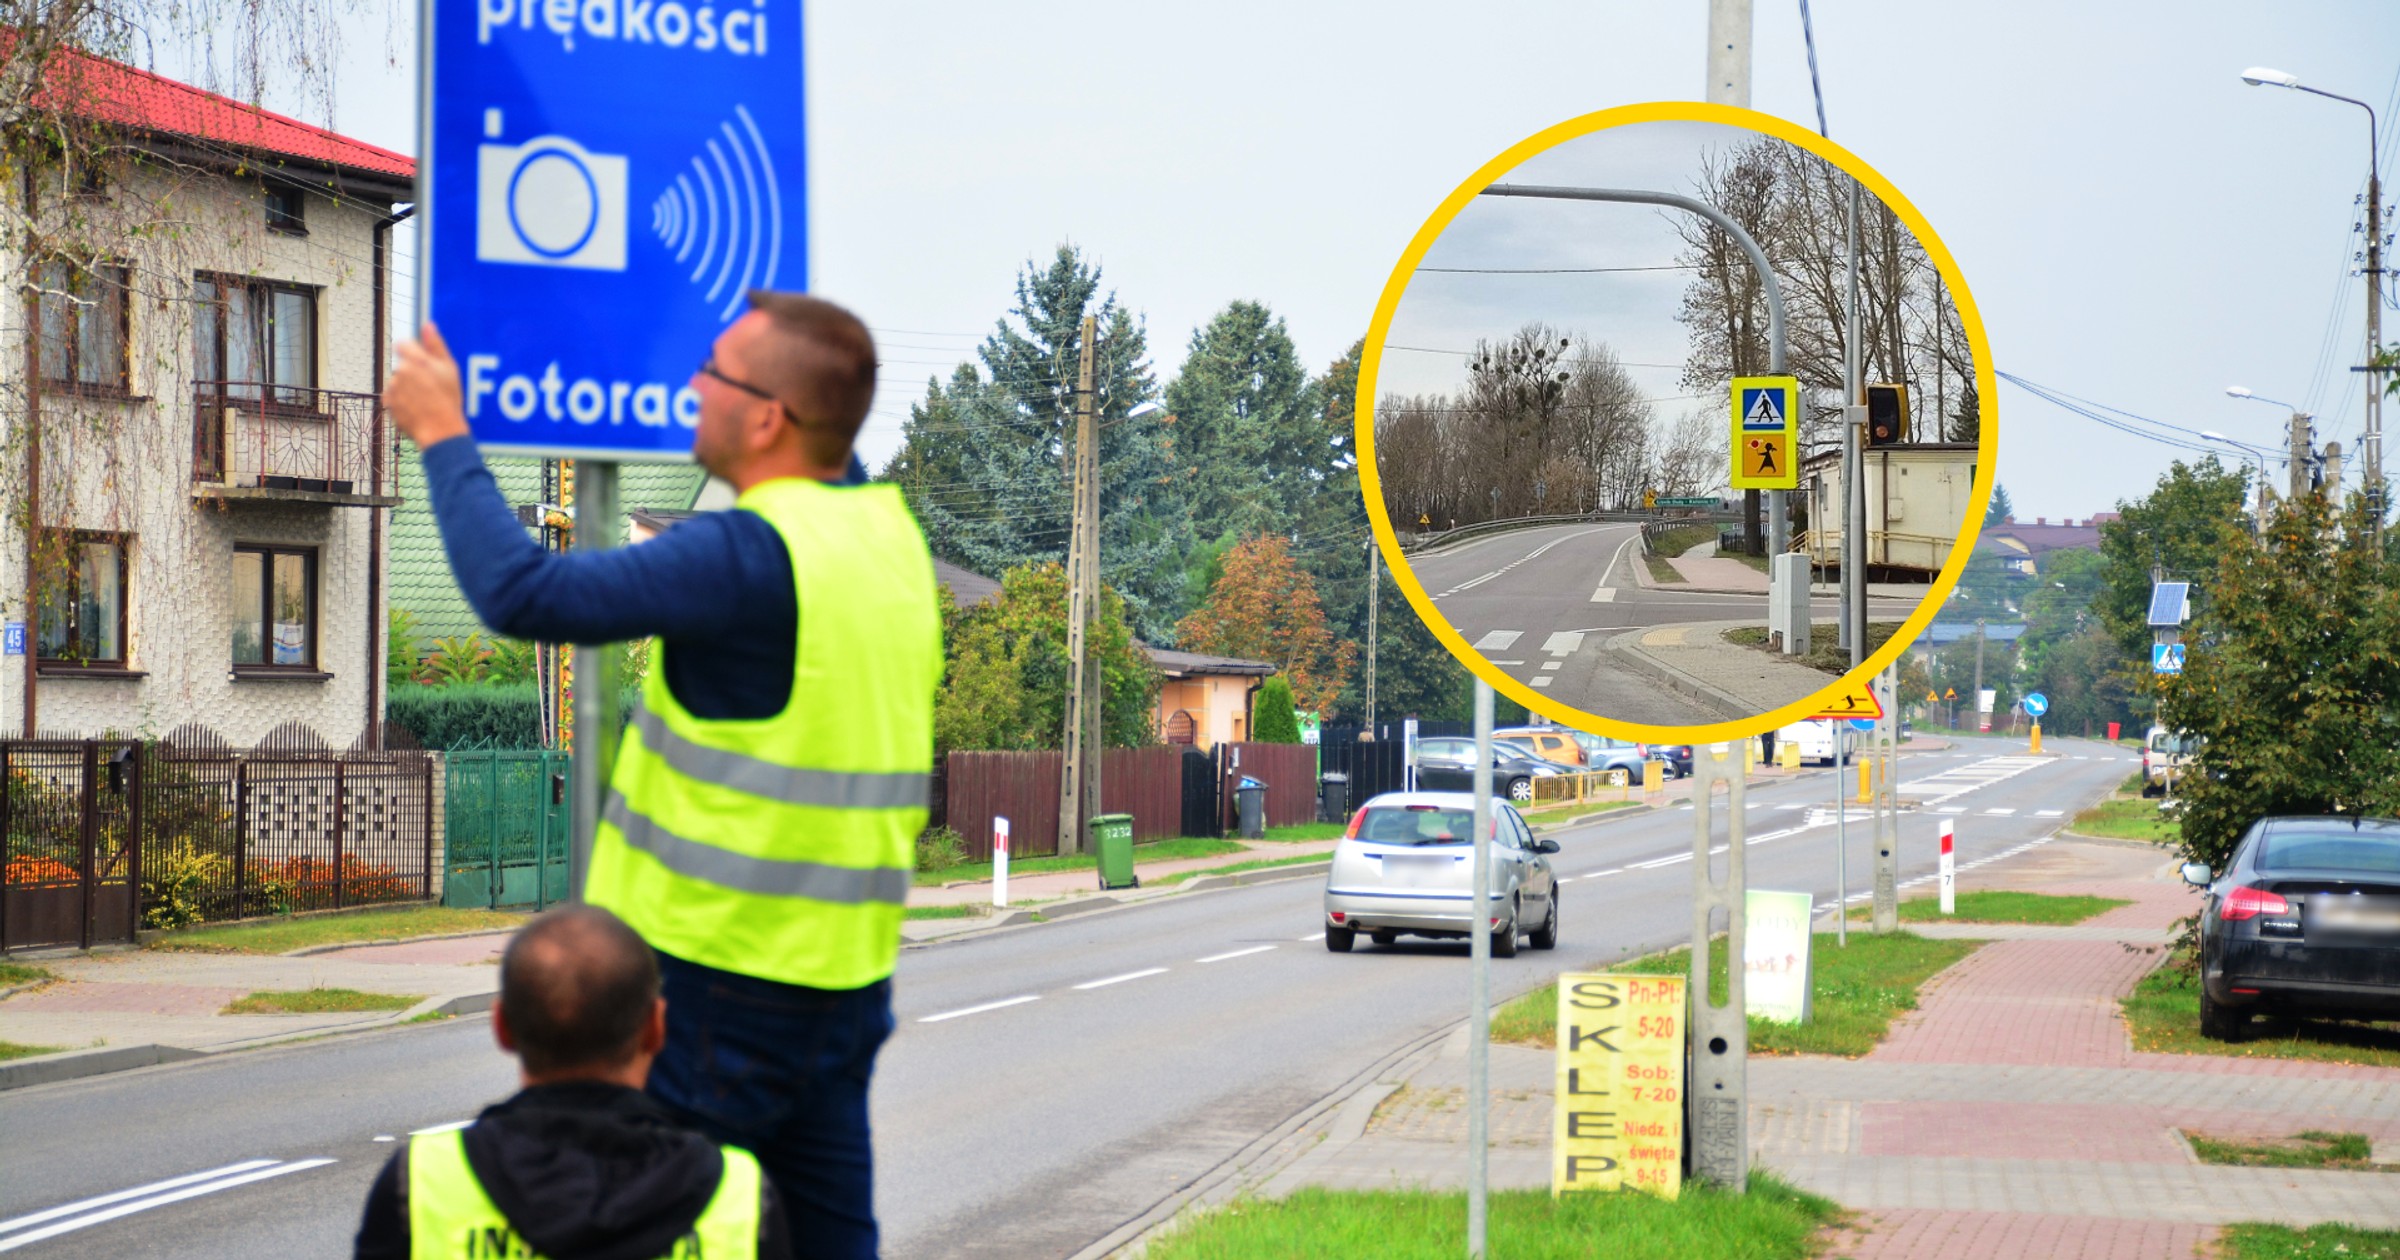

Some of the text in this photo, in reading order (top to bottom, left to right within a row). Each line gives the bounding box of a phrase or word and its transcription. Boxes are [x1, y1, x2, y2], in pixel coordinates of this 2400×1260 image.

[8, 630, 21, 647] 45
[1103, 827, 1132, 839] 3232
[1945, 874, 1951, 886] 7
[1629, 981, 1681, 1004] Pn-Pt:
[1638, 1016, 1675, 1039] 5-20
[1627, 1064, 1676, 1080] Sob:
[1567, 982, 1623, 1182] SKLEP
[1633, 1087, 1677, 1102] 7-20
[1623, 1120, 1678, 1137] Niedz. i
[1629, 1144, 1676, 1165] święta
[1636, 1168, 1668, 1184] 9-15
